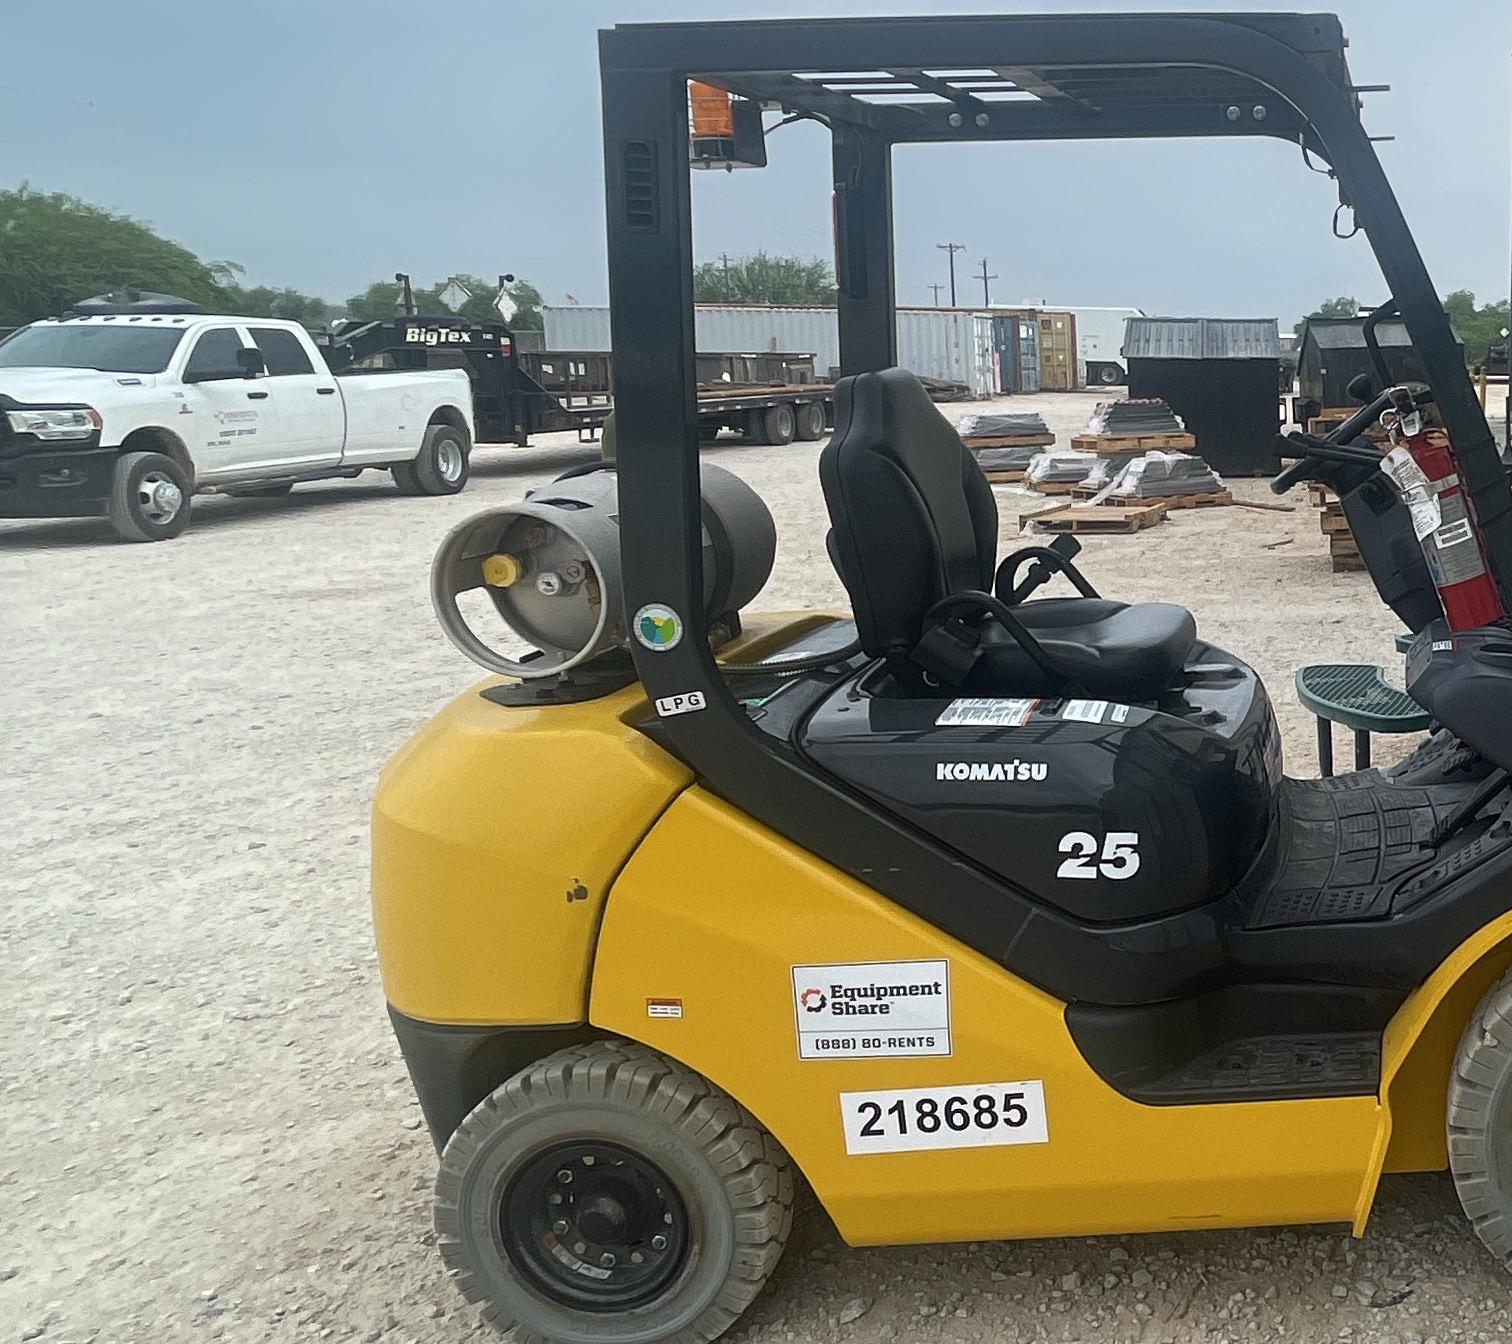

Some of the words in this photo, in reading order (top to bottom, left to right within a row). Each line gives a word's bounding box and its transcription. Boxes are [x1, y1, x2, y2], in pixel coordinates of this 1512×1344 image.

[405, 328, 471, 346] BigTex
[936, 759, 1048, 781] KOMATSU
[1056, 831, 1140, 880] 25
[830, 981, 942, 1001] Equipment
[831, 1002, 891, 1016] Share
[815, 1038, 857, 1050] (888)
[861, 1036, 936, 1049] 80-RENTS
[857, 1092, 1029, 1137] 218685
